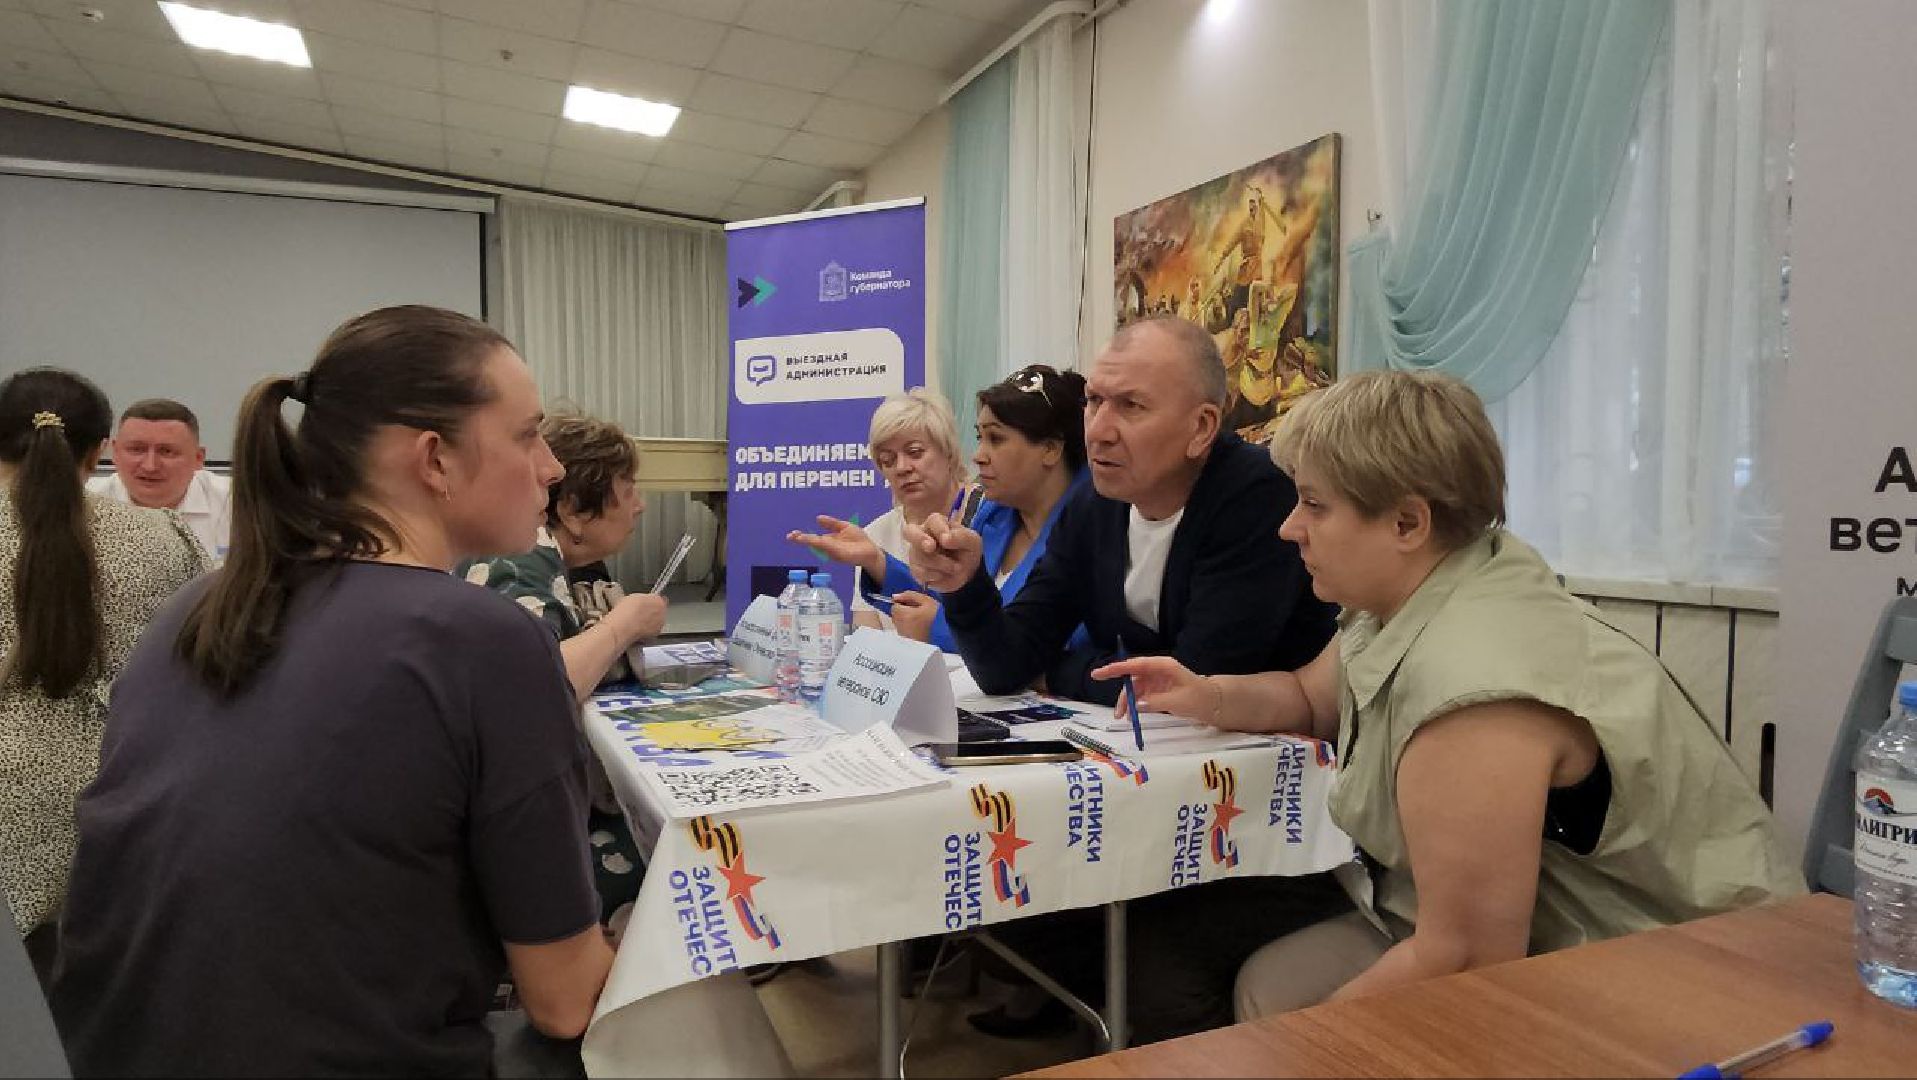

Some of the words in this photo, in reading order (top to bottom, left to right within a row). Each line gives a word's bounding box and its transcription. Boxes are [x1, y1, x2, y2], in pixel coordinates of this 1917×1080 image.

[849, 270, 892, 281] Команда
[849, 279, 911, 294] губернатора
[786, 352, 848, 366] ВЫЕЗДНАЯ
[786, 364, 887, 381] АДМИНИСТРАЦИЯ
[735, 472, 776, 492] ДЛЯ
[780, 469, 875, 489] ПЕРЕМЕН
[1083, 764, 1104, 863] ИТНИКИ
